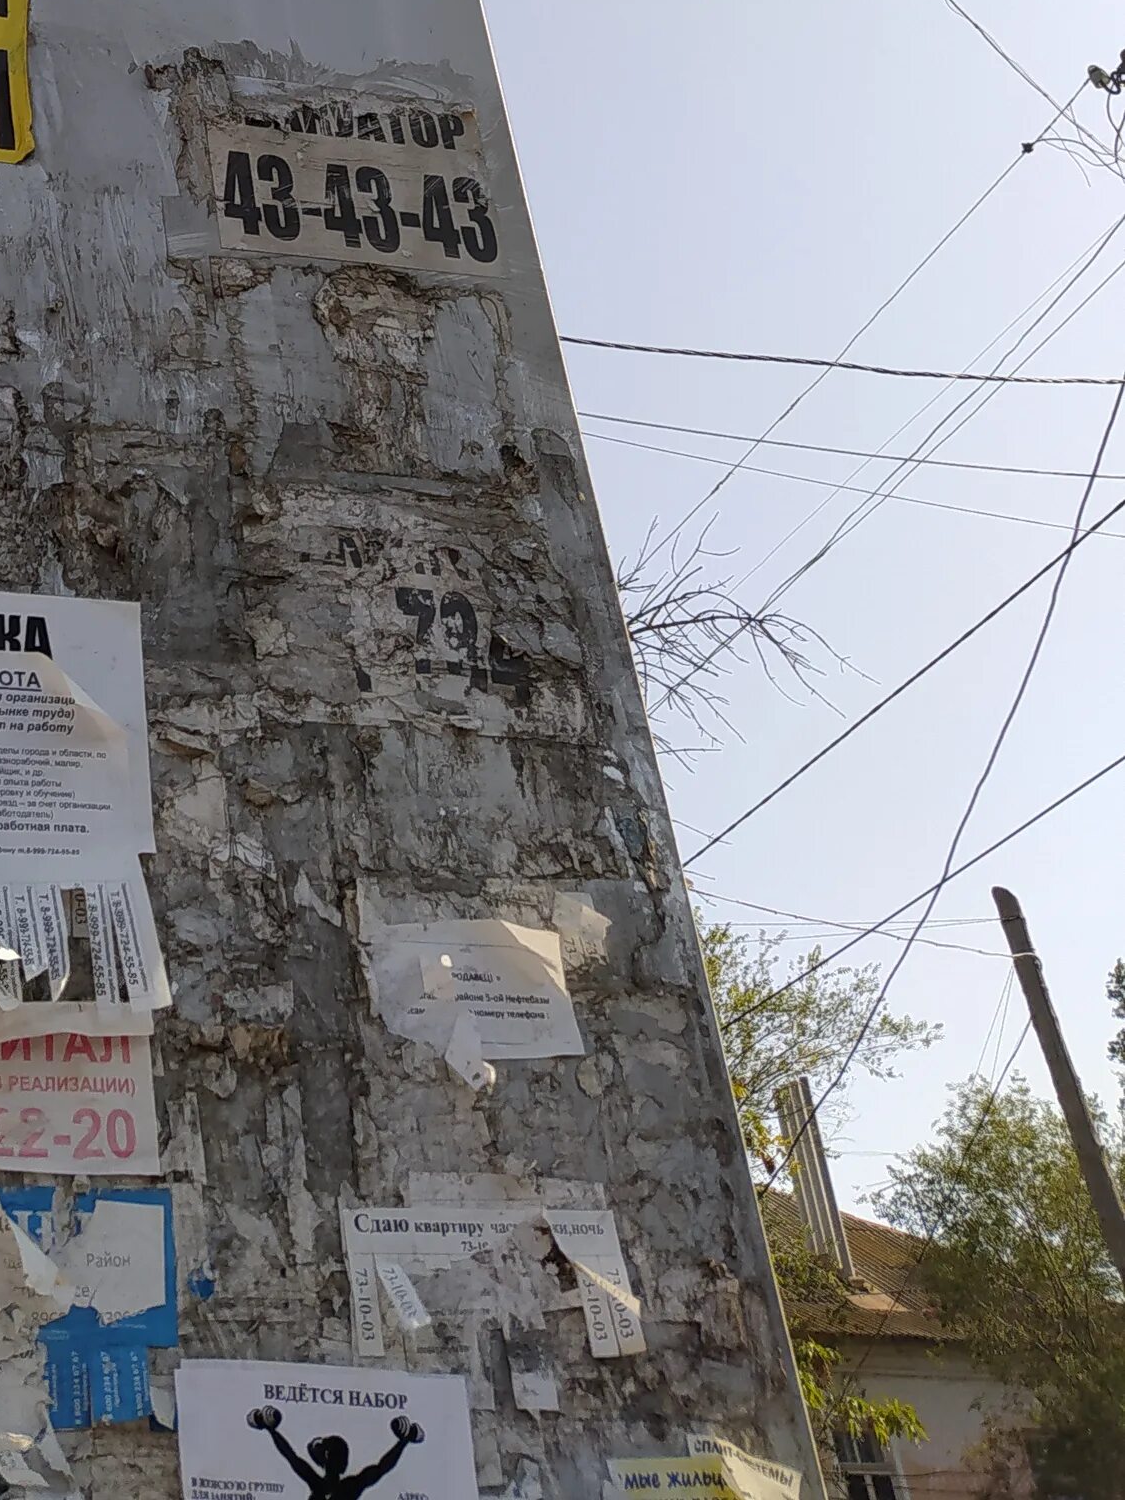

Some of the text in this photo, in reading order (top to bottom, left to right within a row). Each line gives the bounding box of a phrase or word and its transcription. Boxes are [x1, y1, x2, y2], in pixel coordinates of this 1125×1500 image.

[224, 149, 499, 264] 43-43-43
[32, 709, 76, 721] труда)
[9, 721, 74, 736] на работу
[31, 779, 62, 788] работы
[53, 823, 91, 834] плата.
[8, 1074, 137, 1097] РЕАЛИЗАЦИИ)
[353, 1212, 485, 1239] Сдаю квартиру
[86, 1251, 133, 1268] Район
[354, 1267, 376, 1342] 73-10-03
[263, 1383, 409, 1411] ВЕДЁТСЯ НАБОР
